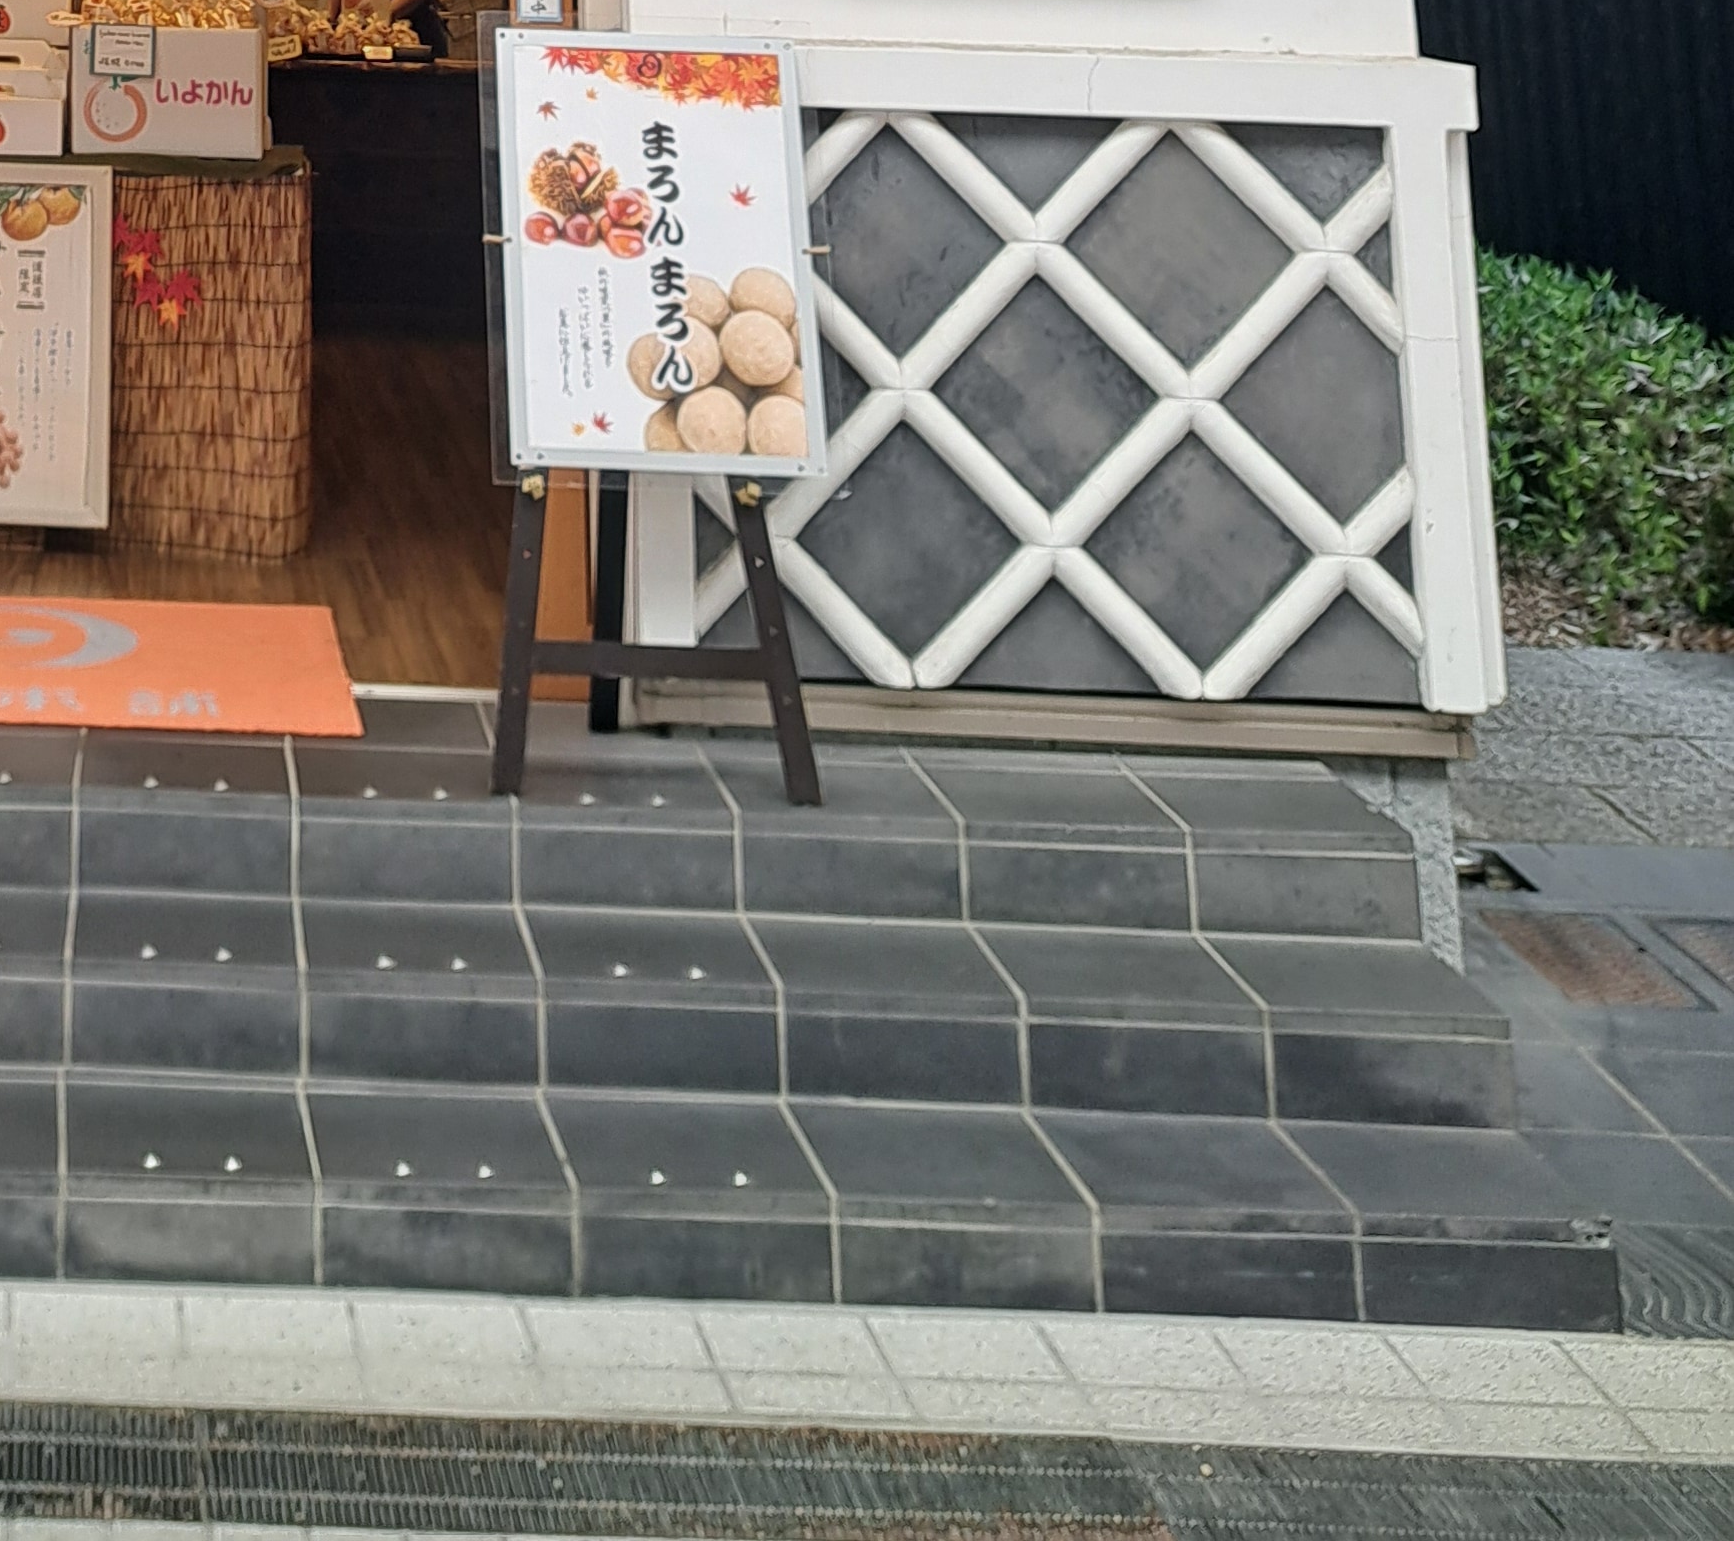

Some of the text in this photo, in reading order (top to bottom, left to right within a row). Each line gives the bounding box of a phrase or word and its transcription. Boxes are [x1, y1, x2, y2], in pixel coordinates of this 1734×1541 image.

[156, 78, 254, 106] いよかん
[641, 121, 696, 393] まろんまろん
